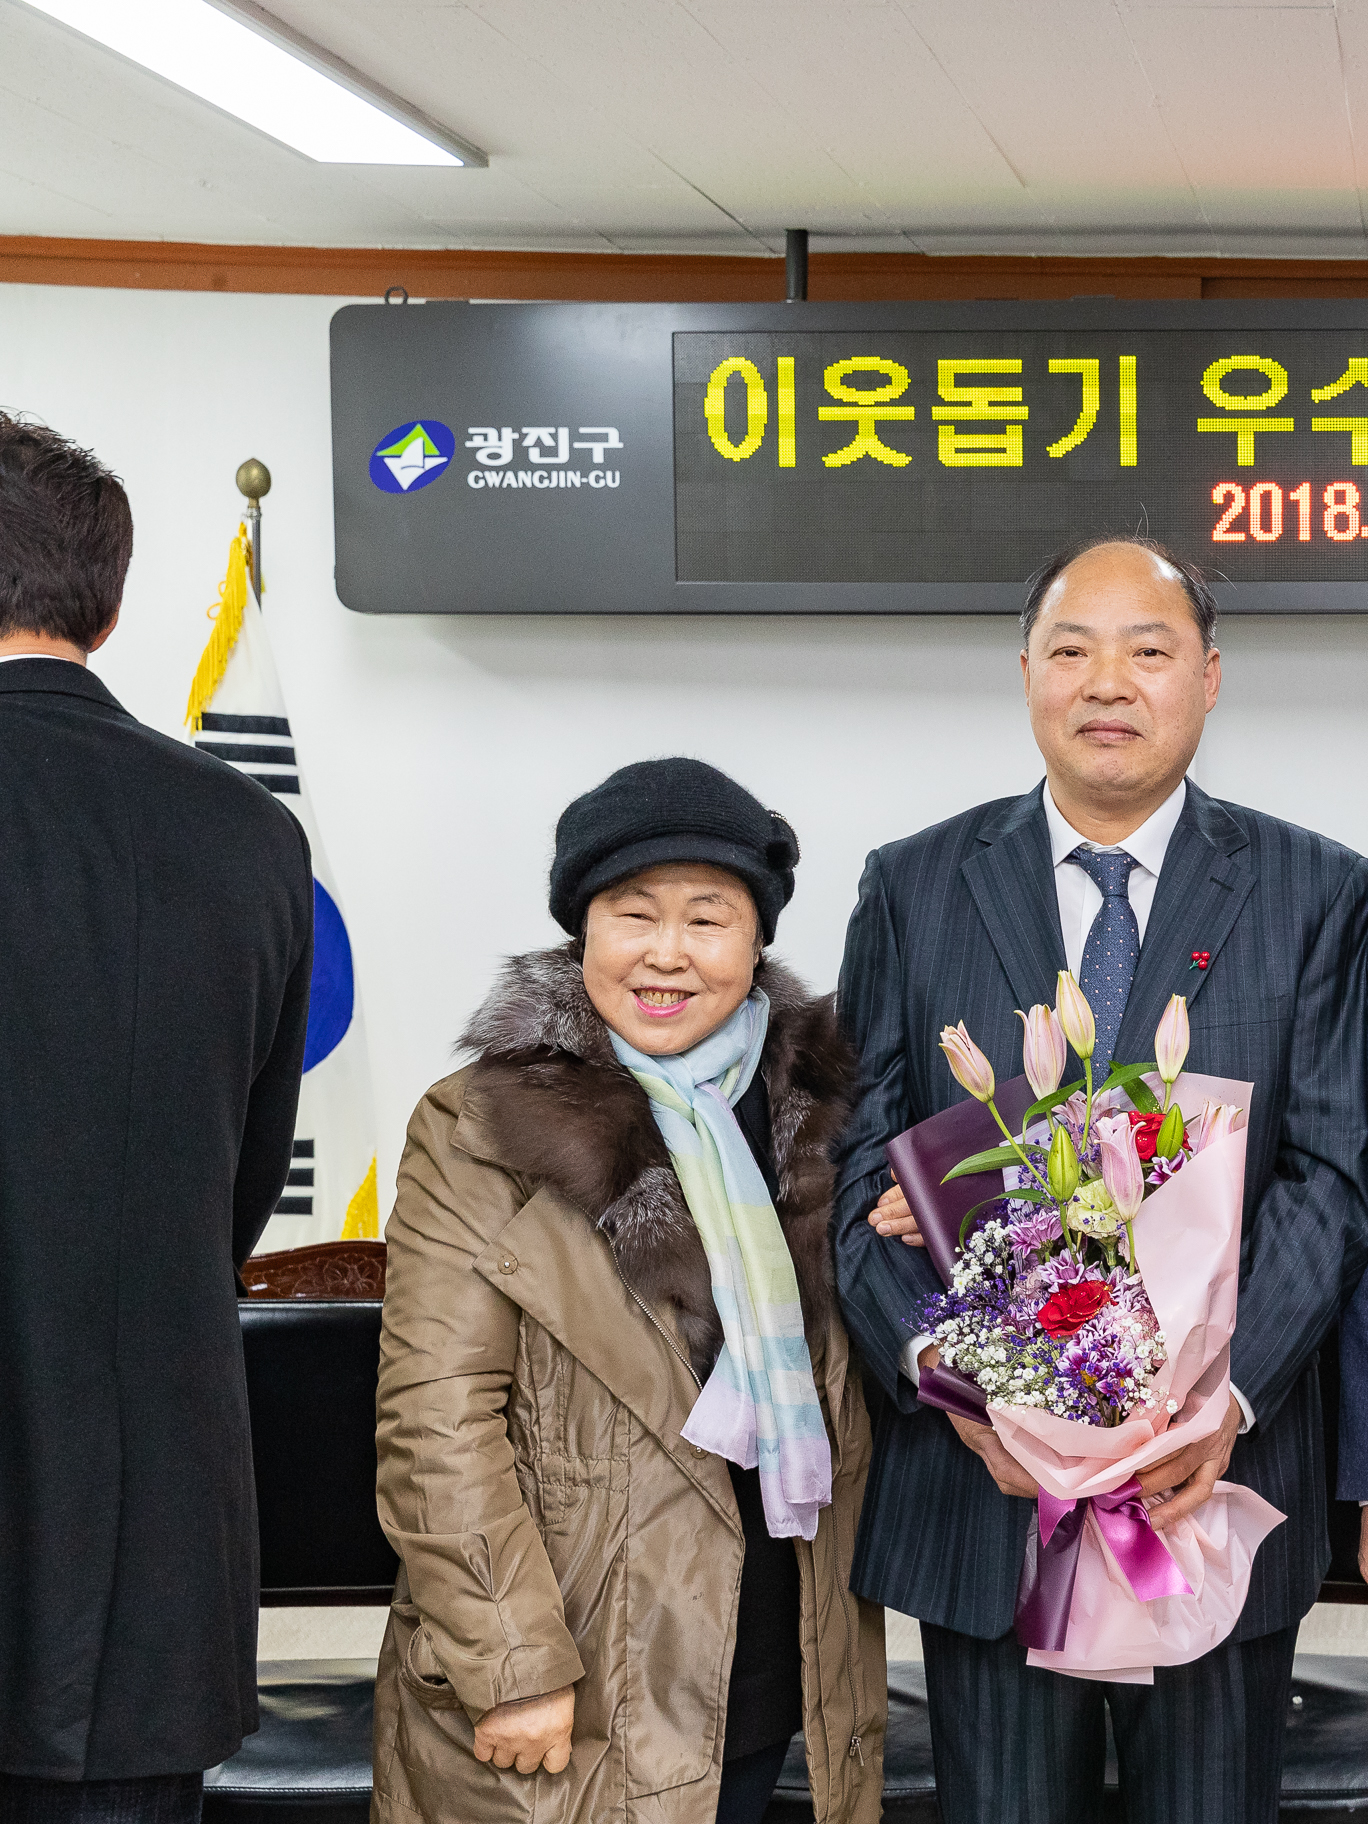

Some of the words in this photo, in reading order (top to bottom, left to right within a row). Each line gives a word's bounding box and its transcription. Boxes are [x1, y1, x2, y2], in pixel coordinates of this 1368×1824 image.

[703, 355, 1138, 468] 이웃돕기
[464, 426, 624, 466] 광진구
[467, 470, 620, 489] GWANGJIN-GU
